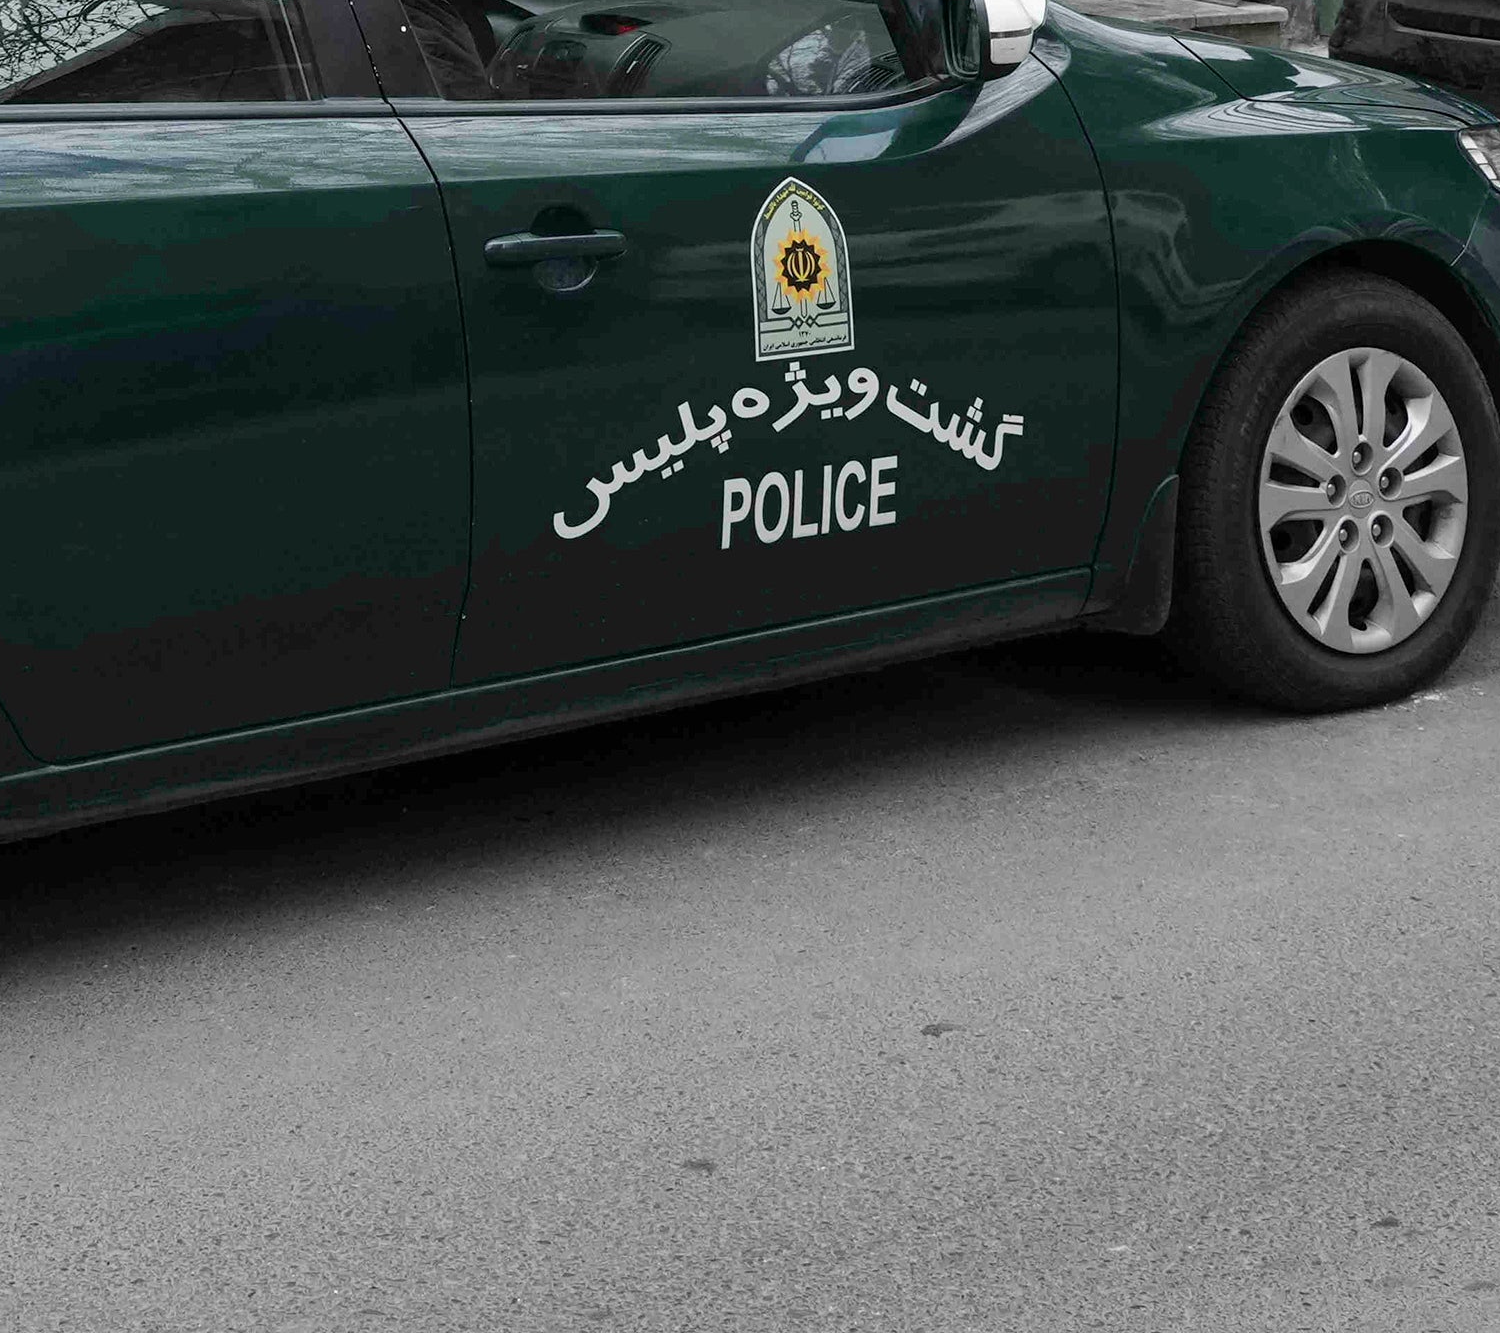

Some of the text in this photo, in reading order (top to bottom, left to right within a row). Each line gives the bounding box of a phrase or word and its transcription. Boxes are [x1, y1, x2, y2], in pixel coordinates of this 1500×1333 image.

[553, 360, 1024, 539] گشت ویژه پلیس
[720, 455, 899, 550] POLICE
